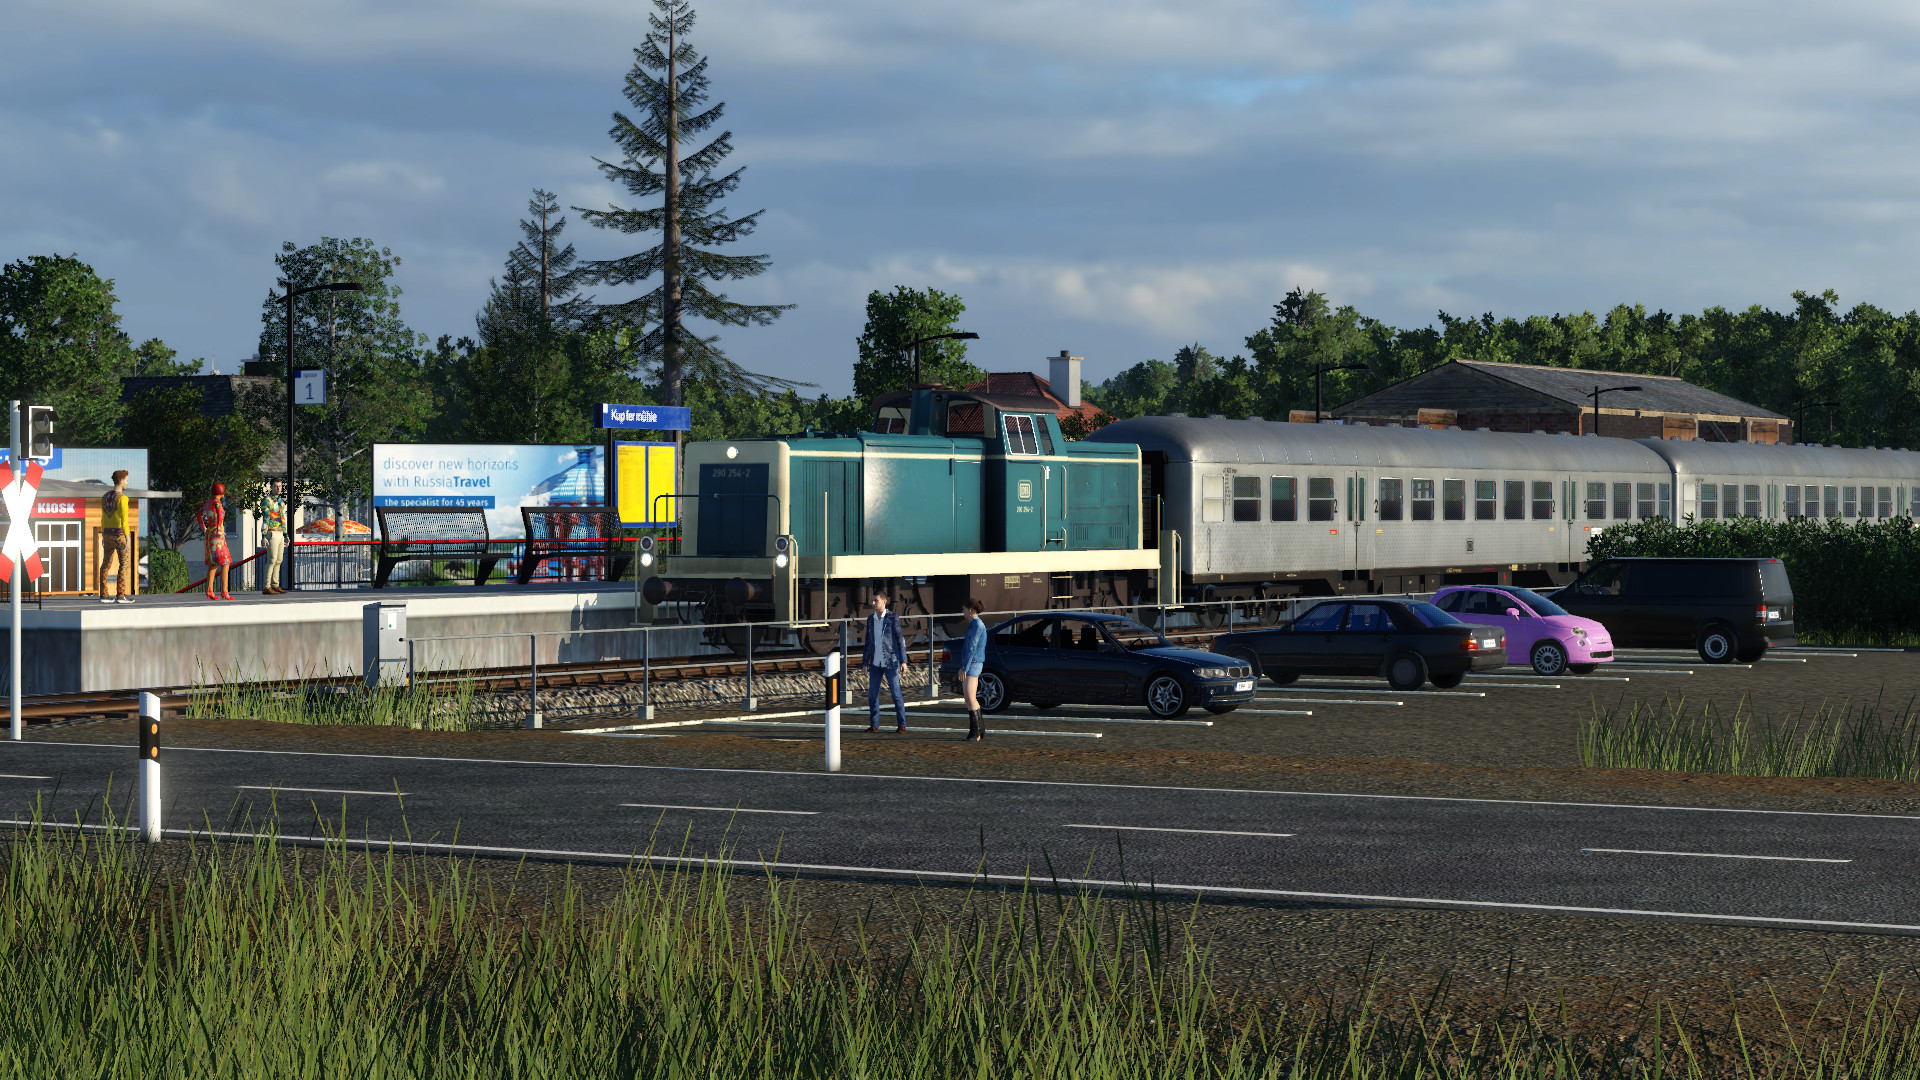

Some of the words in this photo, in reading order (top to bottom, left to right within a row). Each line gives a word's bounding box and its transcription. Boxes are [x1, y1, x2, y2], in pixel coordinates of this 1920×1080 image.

[305, 382, 314, 400] 1
[383, 457, 433, 470] discover
[439, 460, 464, 470] new
[467, 457, 519, 470] horizons
[383, 474, 409, 488] with
[414, 474, 491, 488] RussiaTravel
[37, 502, 76, 514] KIOSK
[385, 498, 399, 507] the
[400, 497, 440, 508] specialist
[442, 497, 454, 507] for
[455, 498, 465, 507] 45
[466, 499, 489, 508] years
